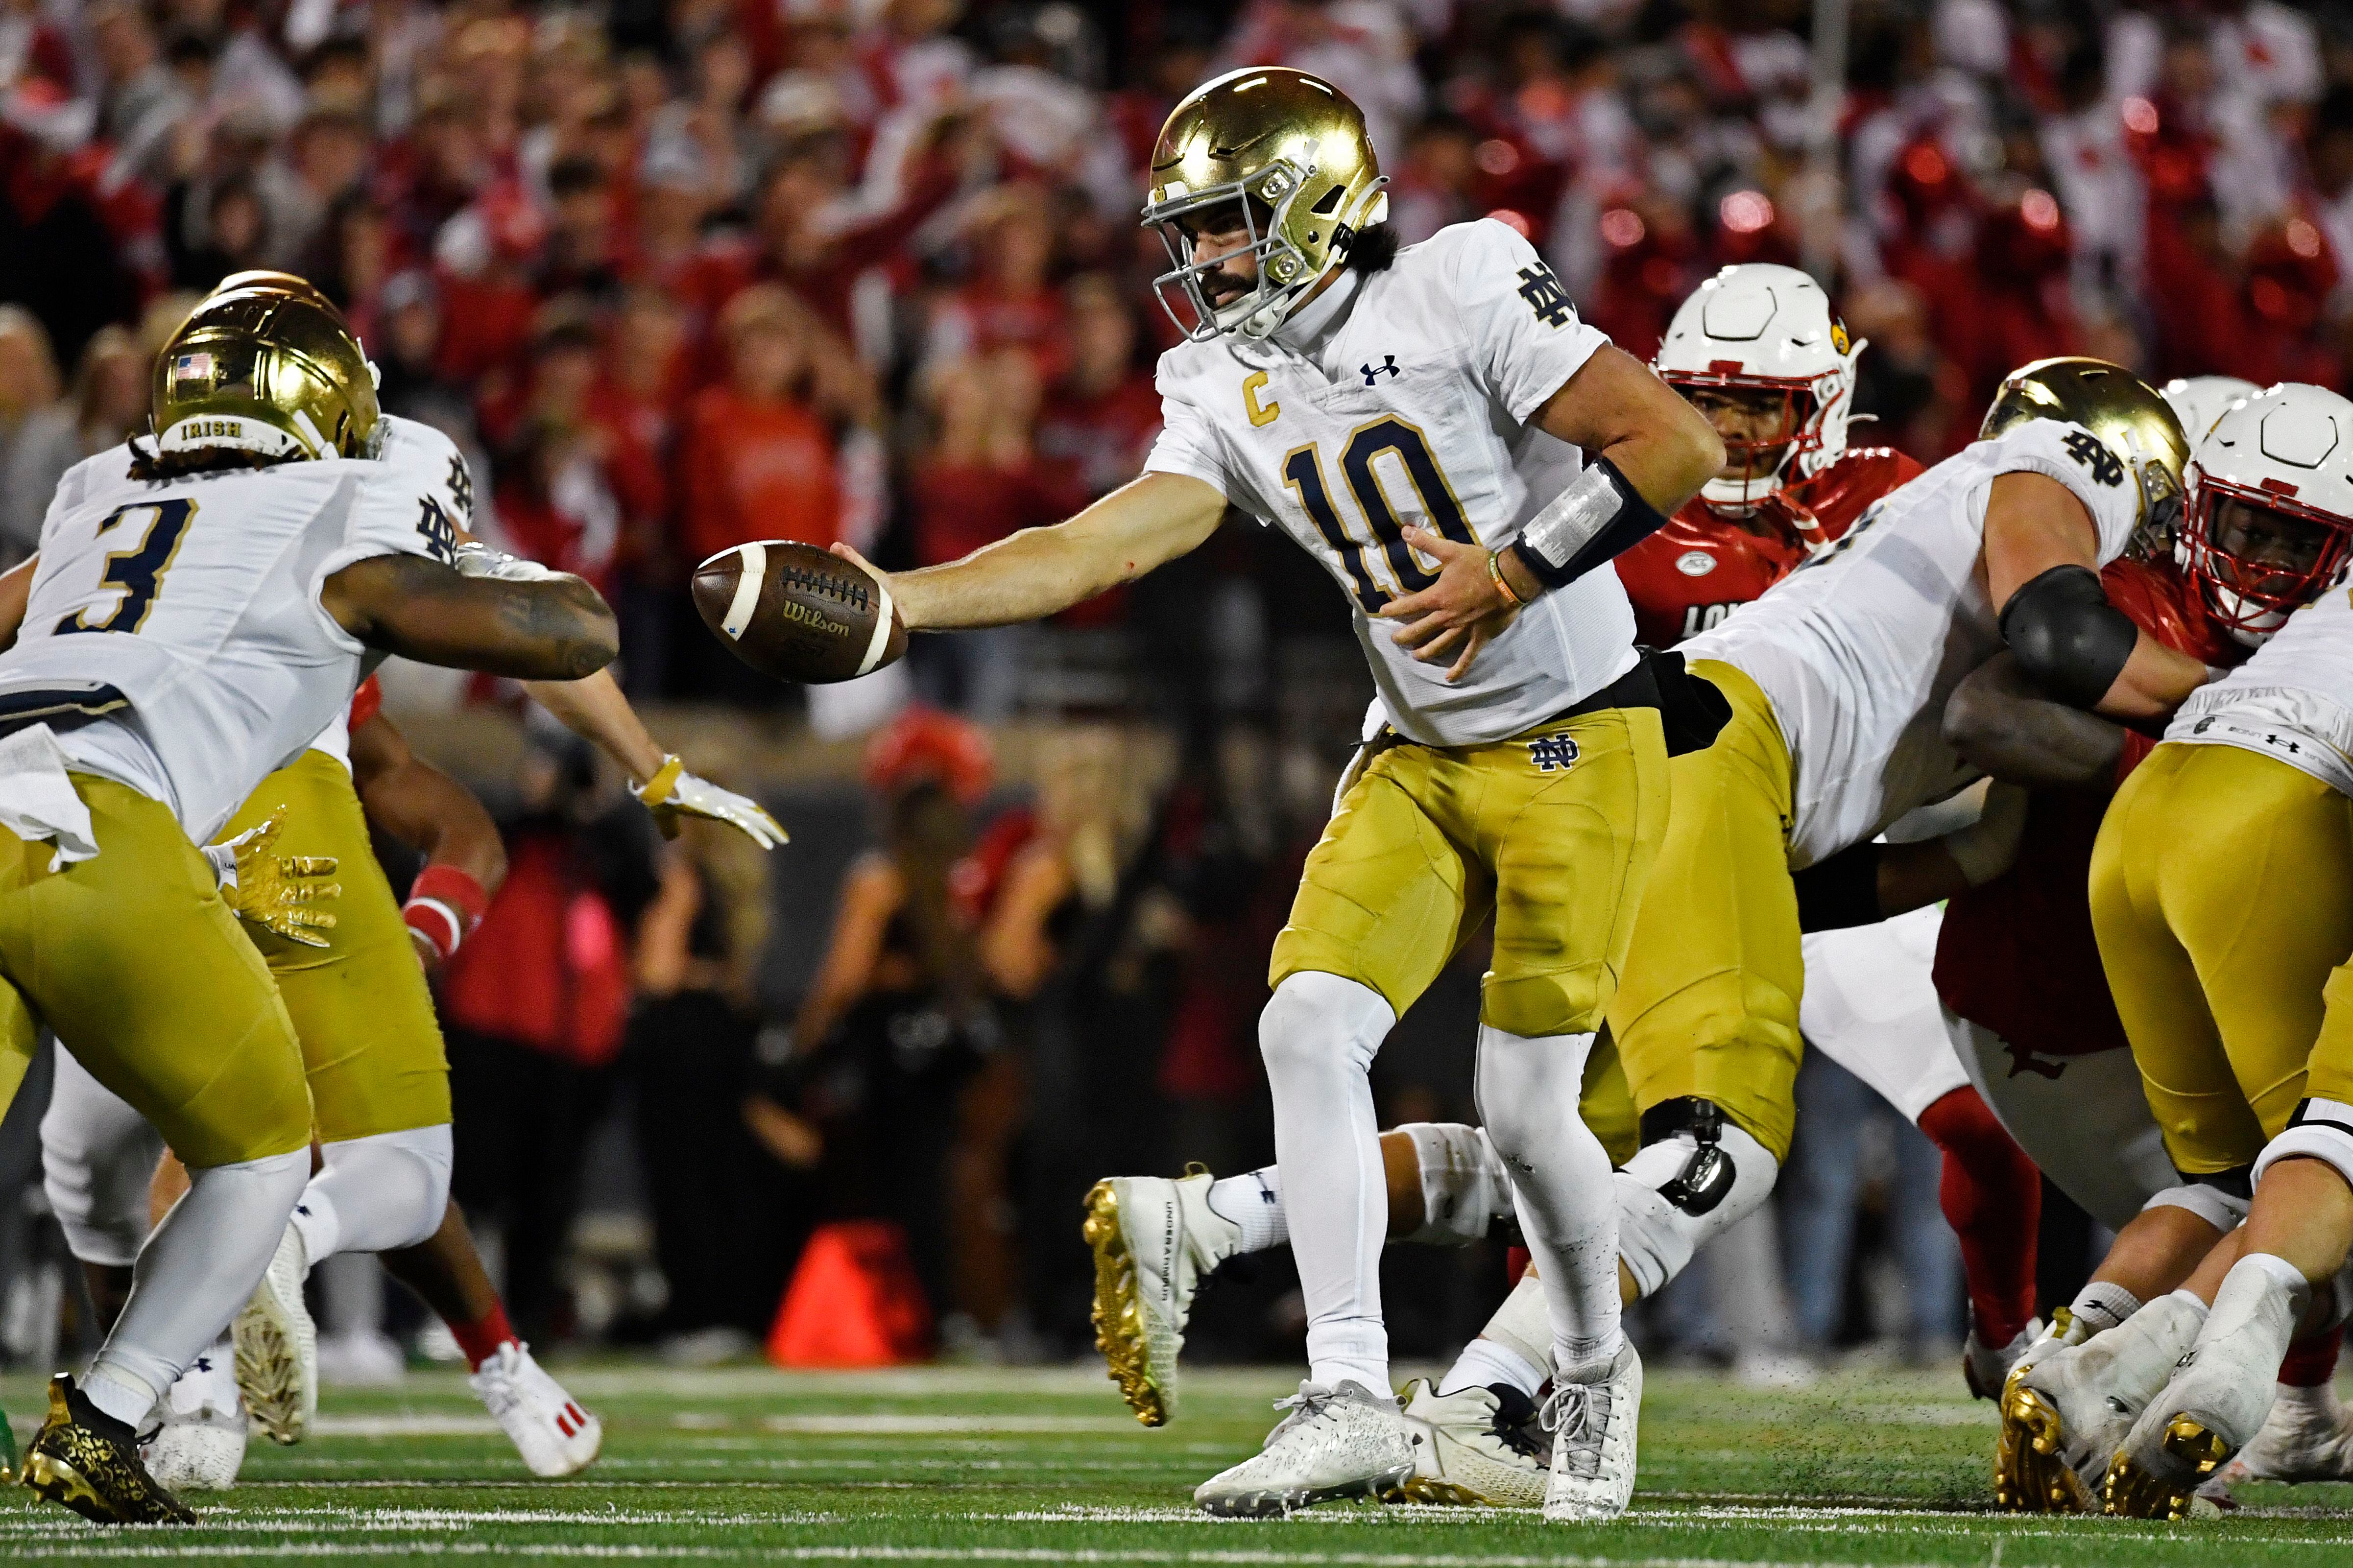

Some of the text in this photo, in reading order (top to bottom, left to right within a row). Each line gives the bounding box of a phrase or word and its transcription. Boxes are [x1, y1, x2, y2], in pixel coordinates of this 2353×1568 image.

[1242, 370, 1280, 428] C
[181, 421, 241, 441] IRISH
[1281, 412, 1482, 618] 10
[51, 498, 199, 636] 3
[783, 600, 850, 636] Wilson
